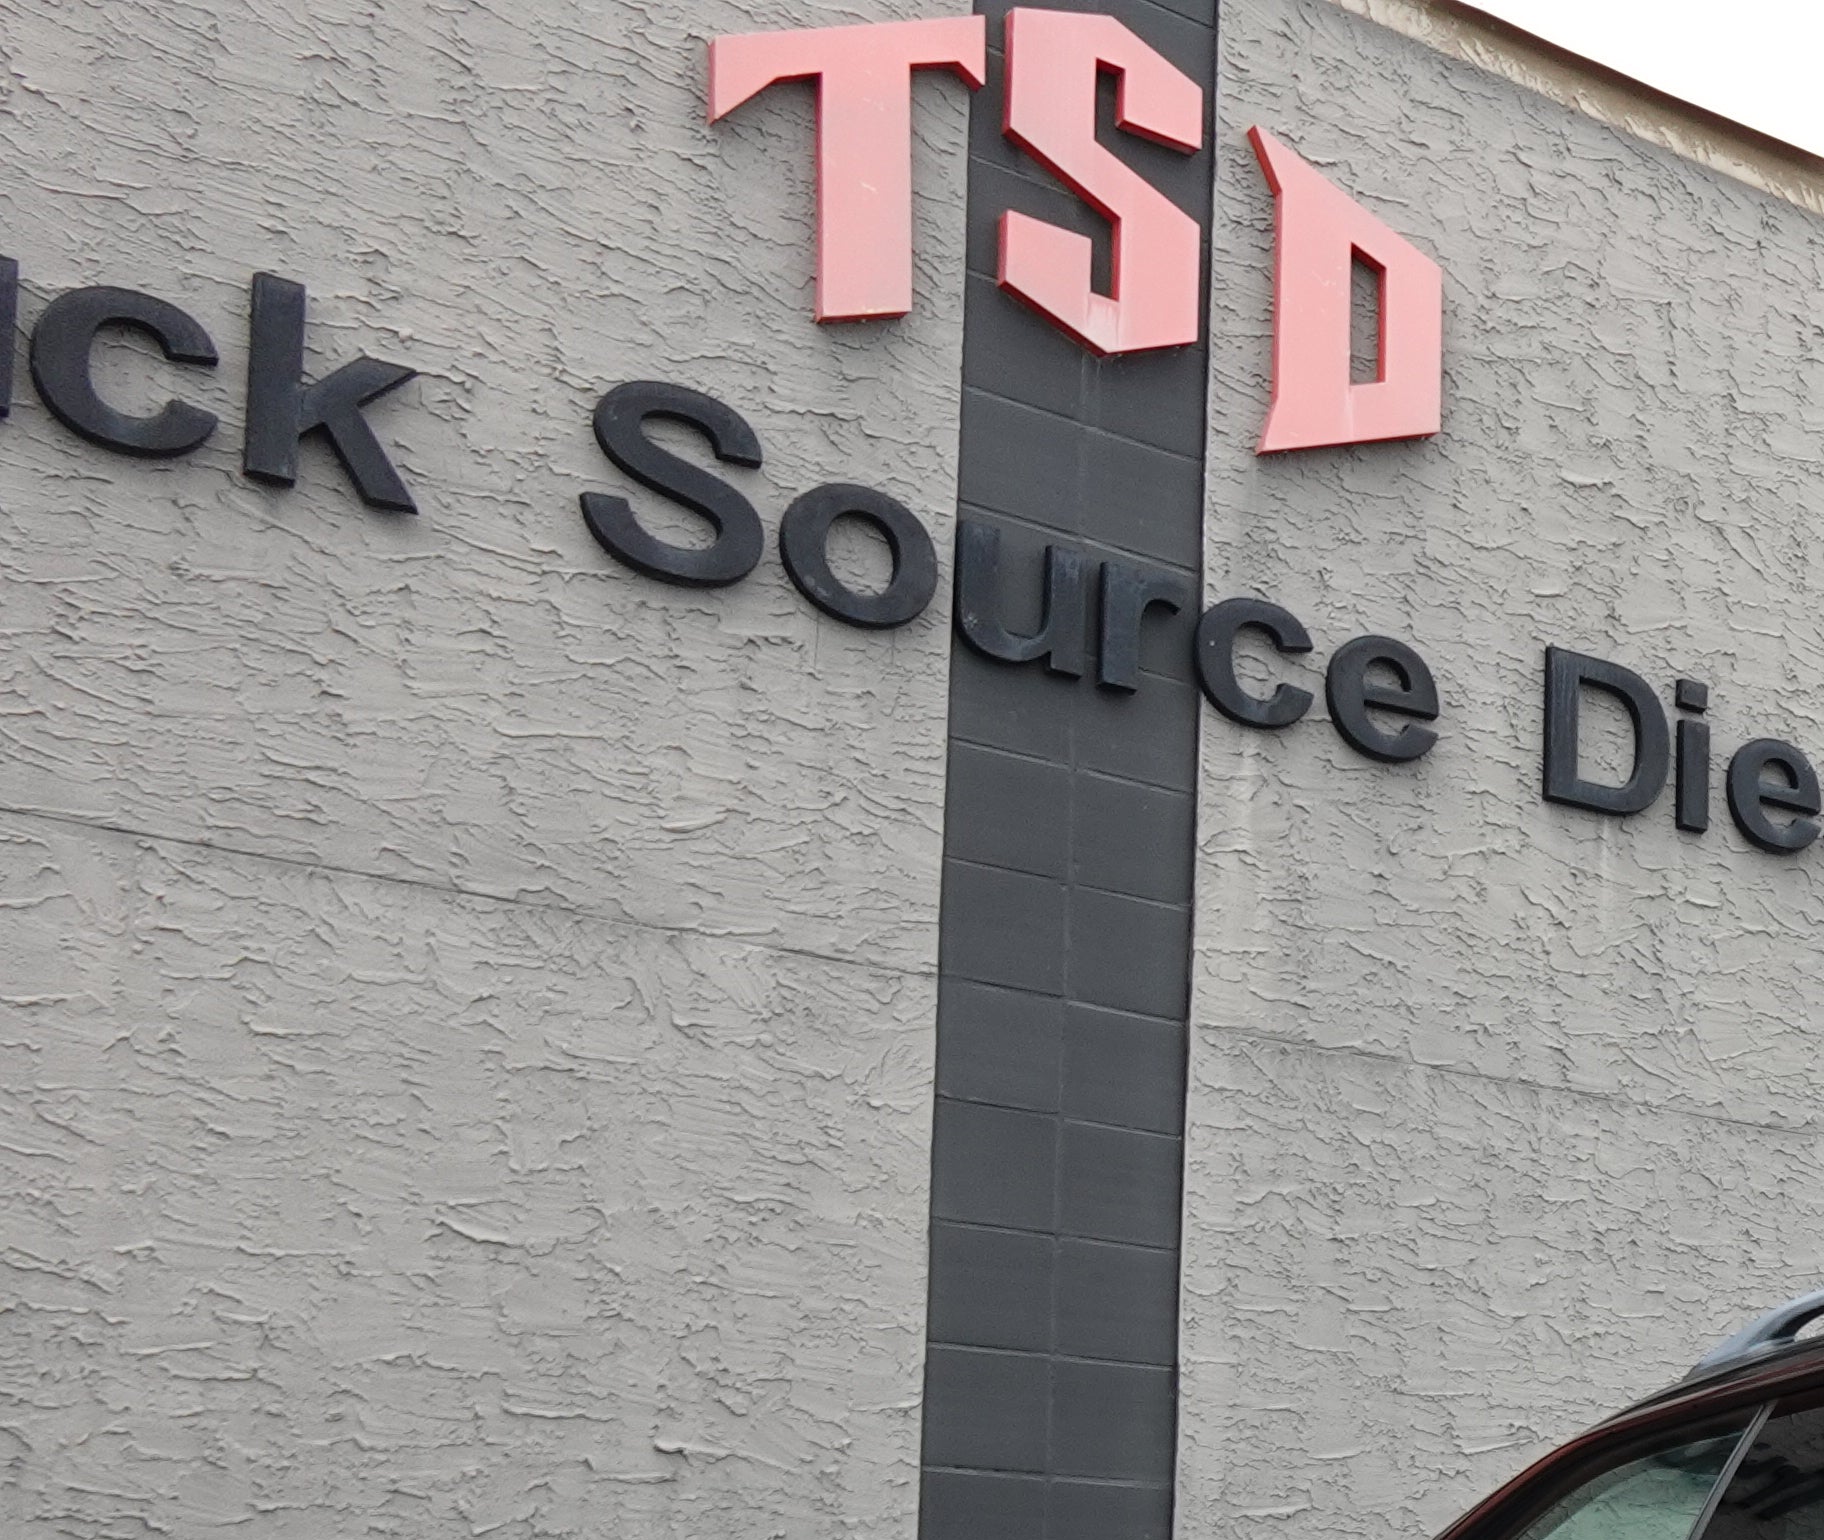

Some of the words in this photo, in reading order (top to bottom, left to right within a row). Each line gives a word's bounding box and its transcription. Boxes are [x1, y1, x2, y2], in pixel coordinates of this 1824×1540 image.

[709, 8, 1442, 456] TSD
[0, 254, 419, 515] ck
[580, 380, 1440, 764] Source
